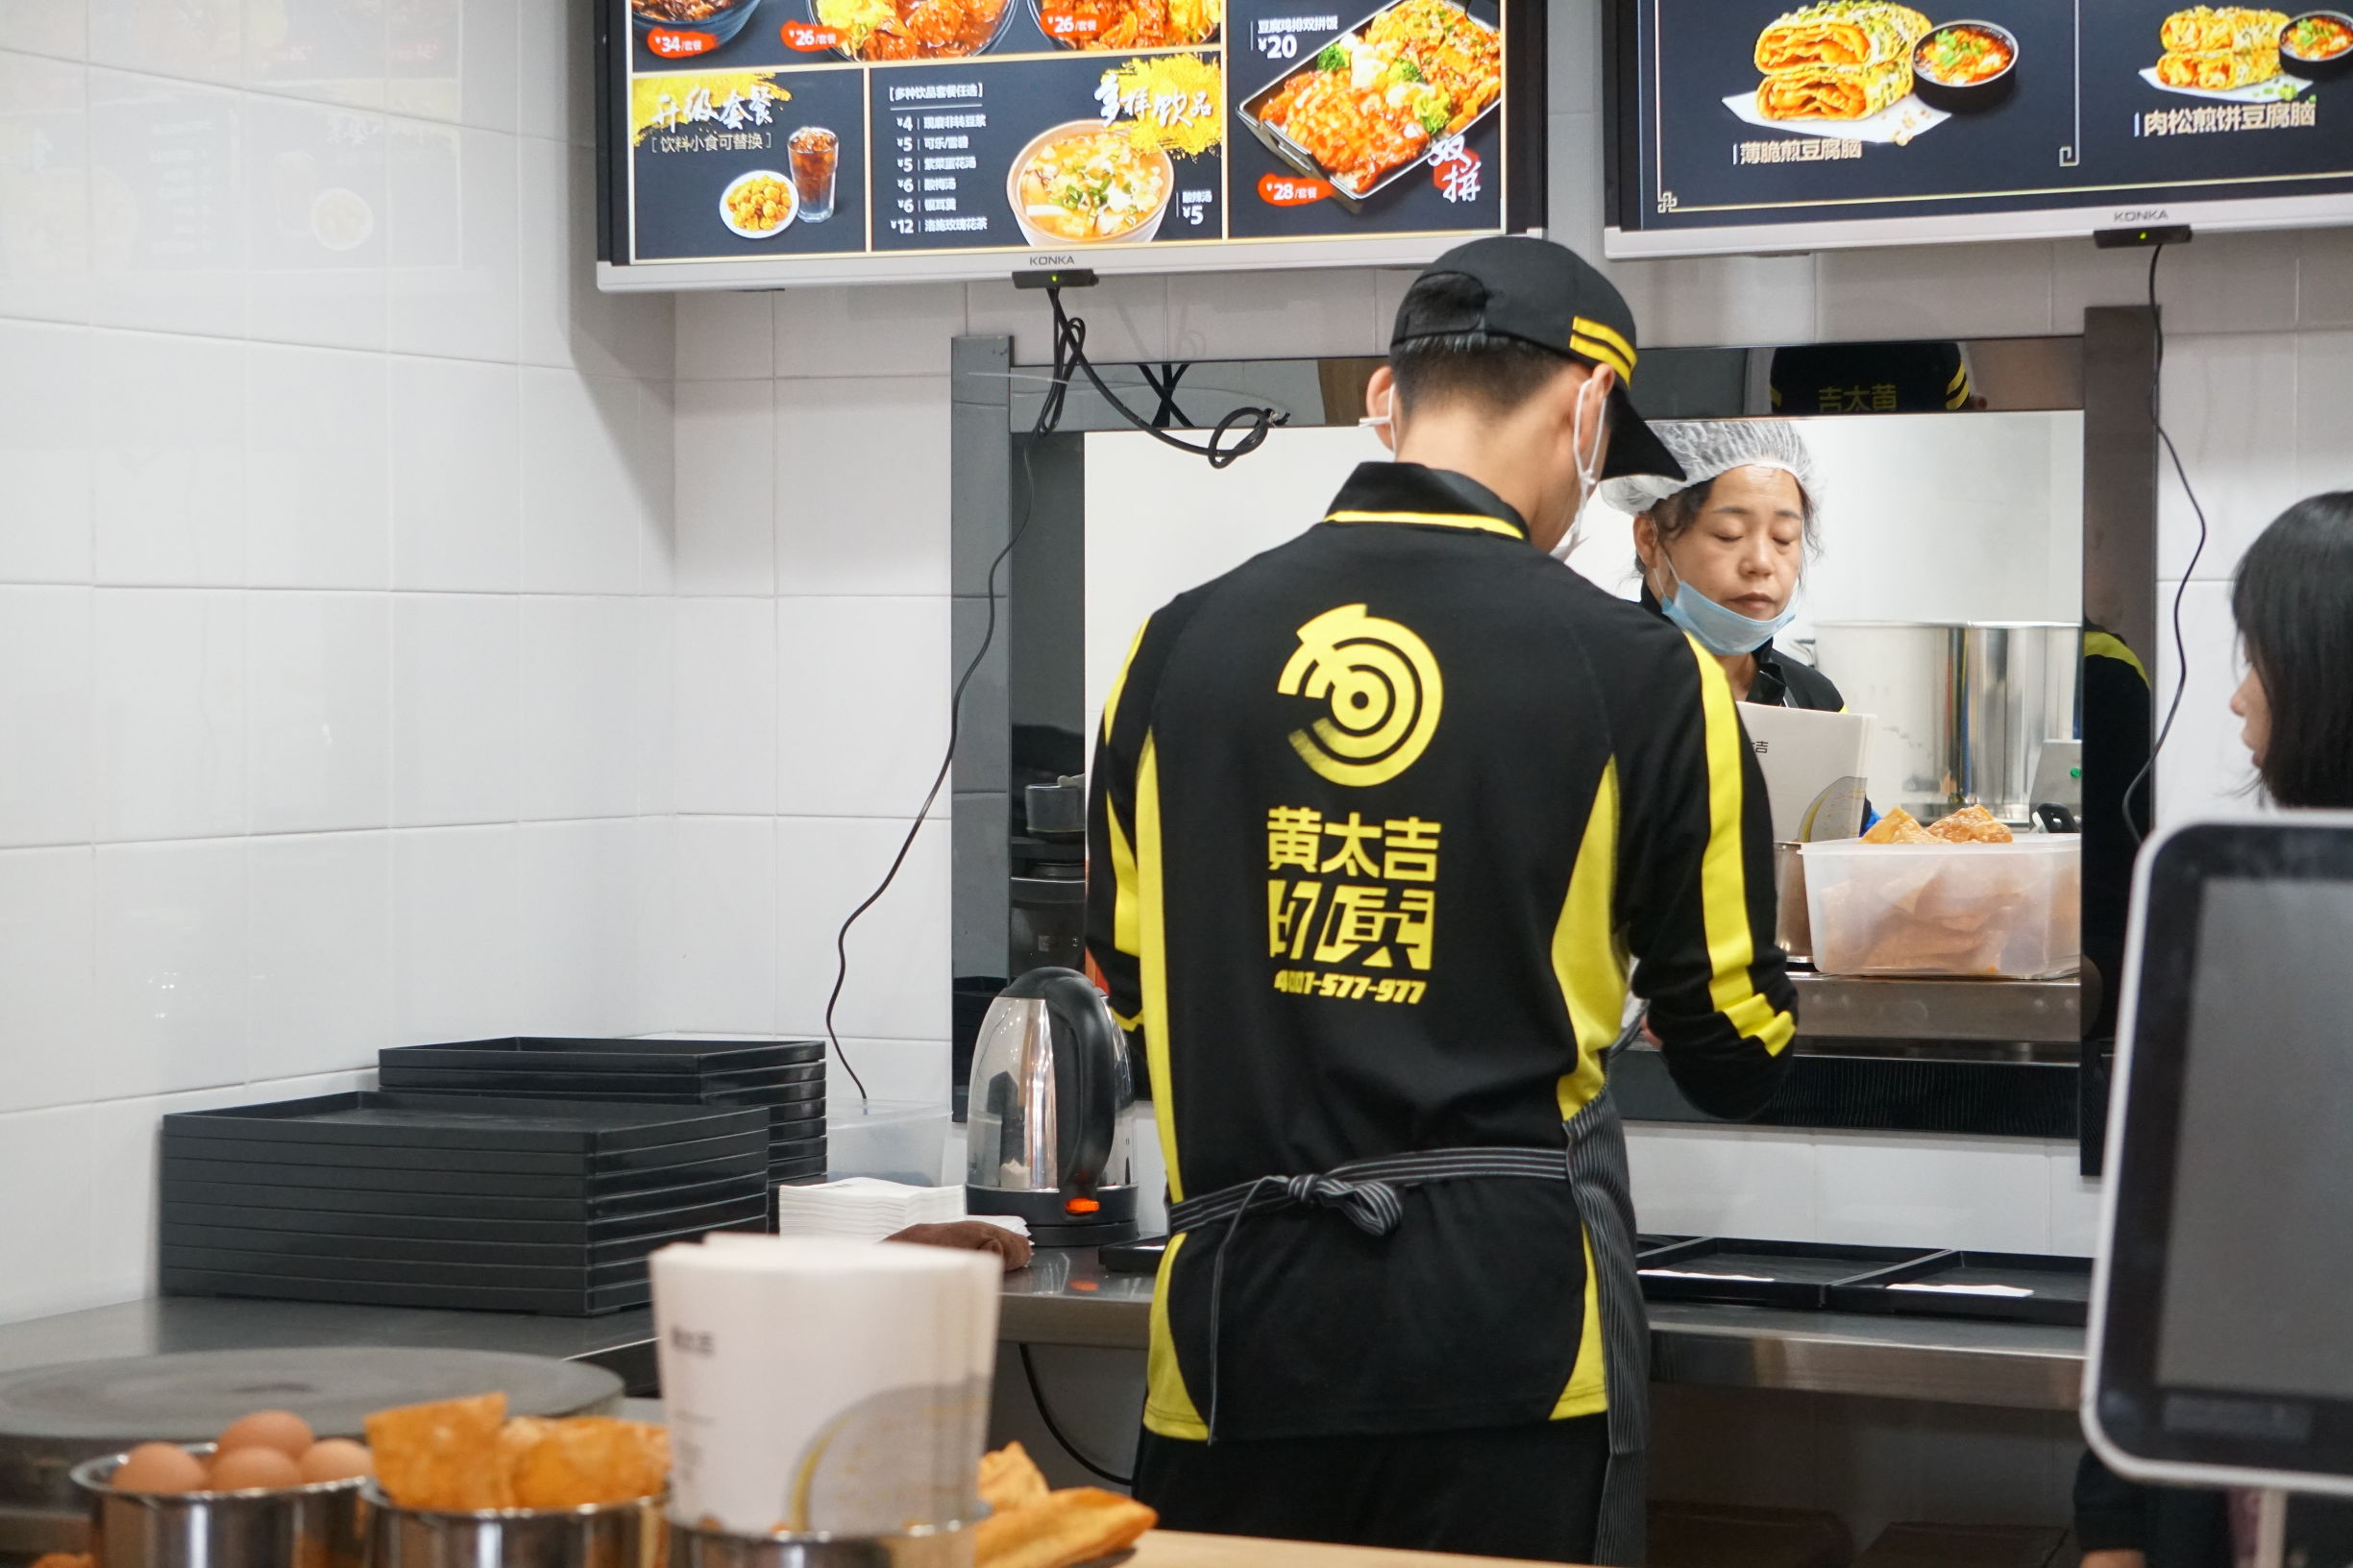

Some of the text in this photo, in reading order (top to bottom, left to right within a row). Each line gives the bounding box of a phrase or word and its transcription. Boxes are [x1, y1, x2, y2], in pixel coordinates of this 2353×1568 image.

[1258, 34, 1297, 59] ¥20
[2144, 101, 2316, 137] 肉松煎饼豆腐脑
[1740, 137, 1863, 165] 薄脆煎豆腐脑
[1182, 204, 1205, 226] ¥5
[2114, 209, 2169, 222] KONKA
[1029, 255, 1075, 265] KONKA
[1266, 805, 1442, 882] 黄太吉
